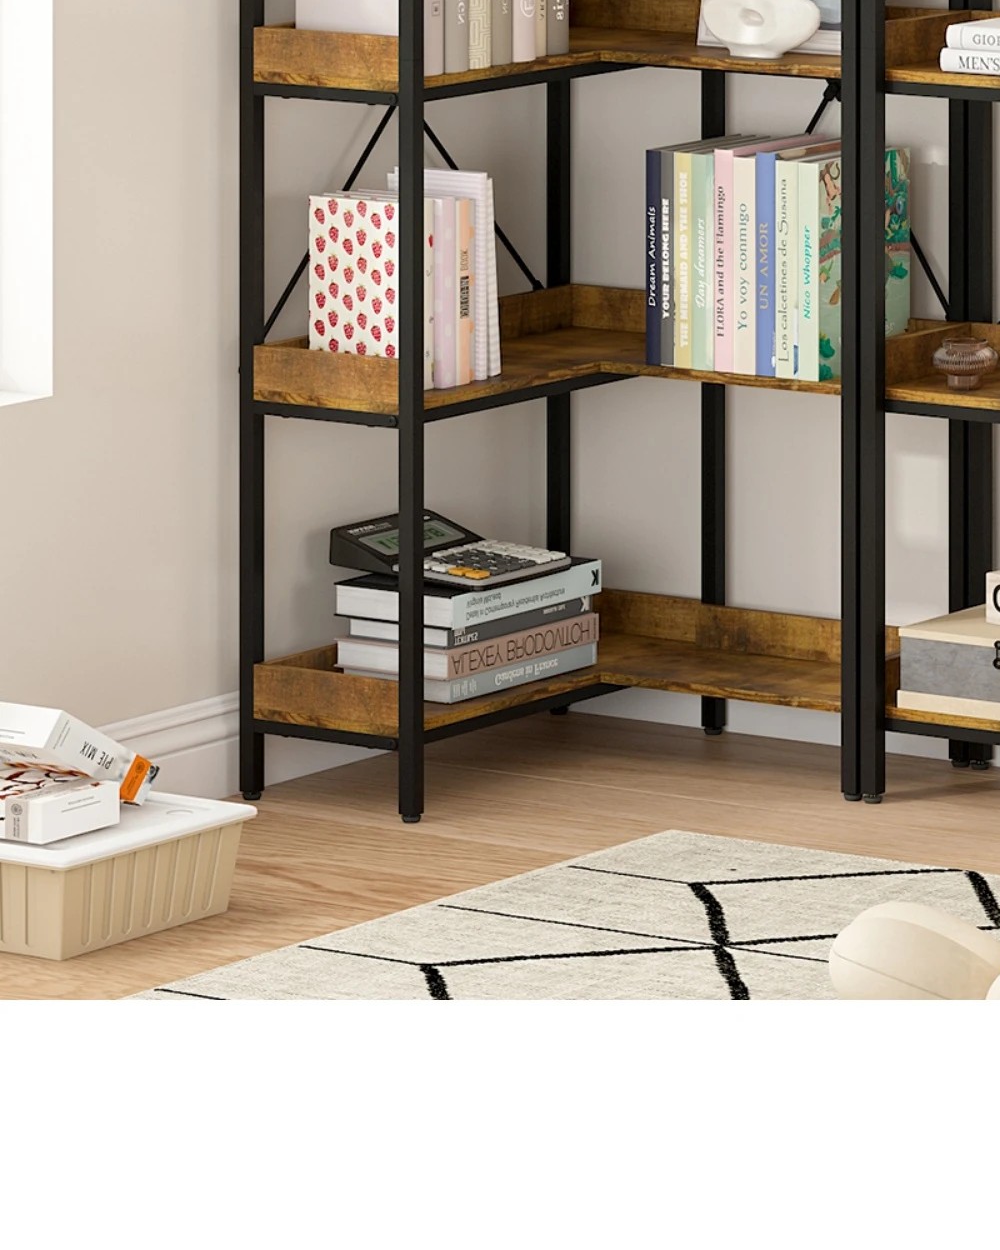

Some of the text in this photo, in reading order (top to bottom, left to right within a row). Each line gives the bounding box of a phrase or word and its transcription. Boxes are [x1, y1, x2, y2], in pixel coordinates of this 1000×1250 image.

[647, 206, 656, 307] Dream Animals
[662, 198, 670, 319] YOUR BELONG HERE
[680, 207, 688, 232] THE
[680, 234, 688, 259] AND
[694, 218, 708, 308] Day dreamers
[716, 185, 726, 337] FLORA and the Flamingo
[759, 222, 768, 309] UN AMOR
[737, 203, 749, 330] Yo voy conmigo
[777, 179, 789, 362] Los calcetines de Susana
[802, 225, 812, 319] Nico Whopper
[680, 323, 688, 348] THE
[80, 741, 115, 770] PIE MIX
